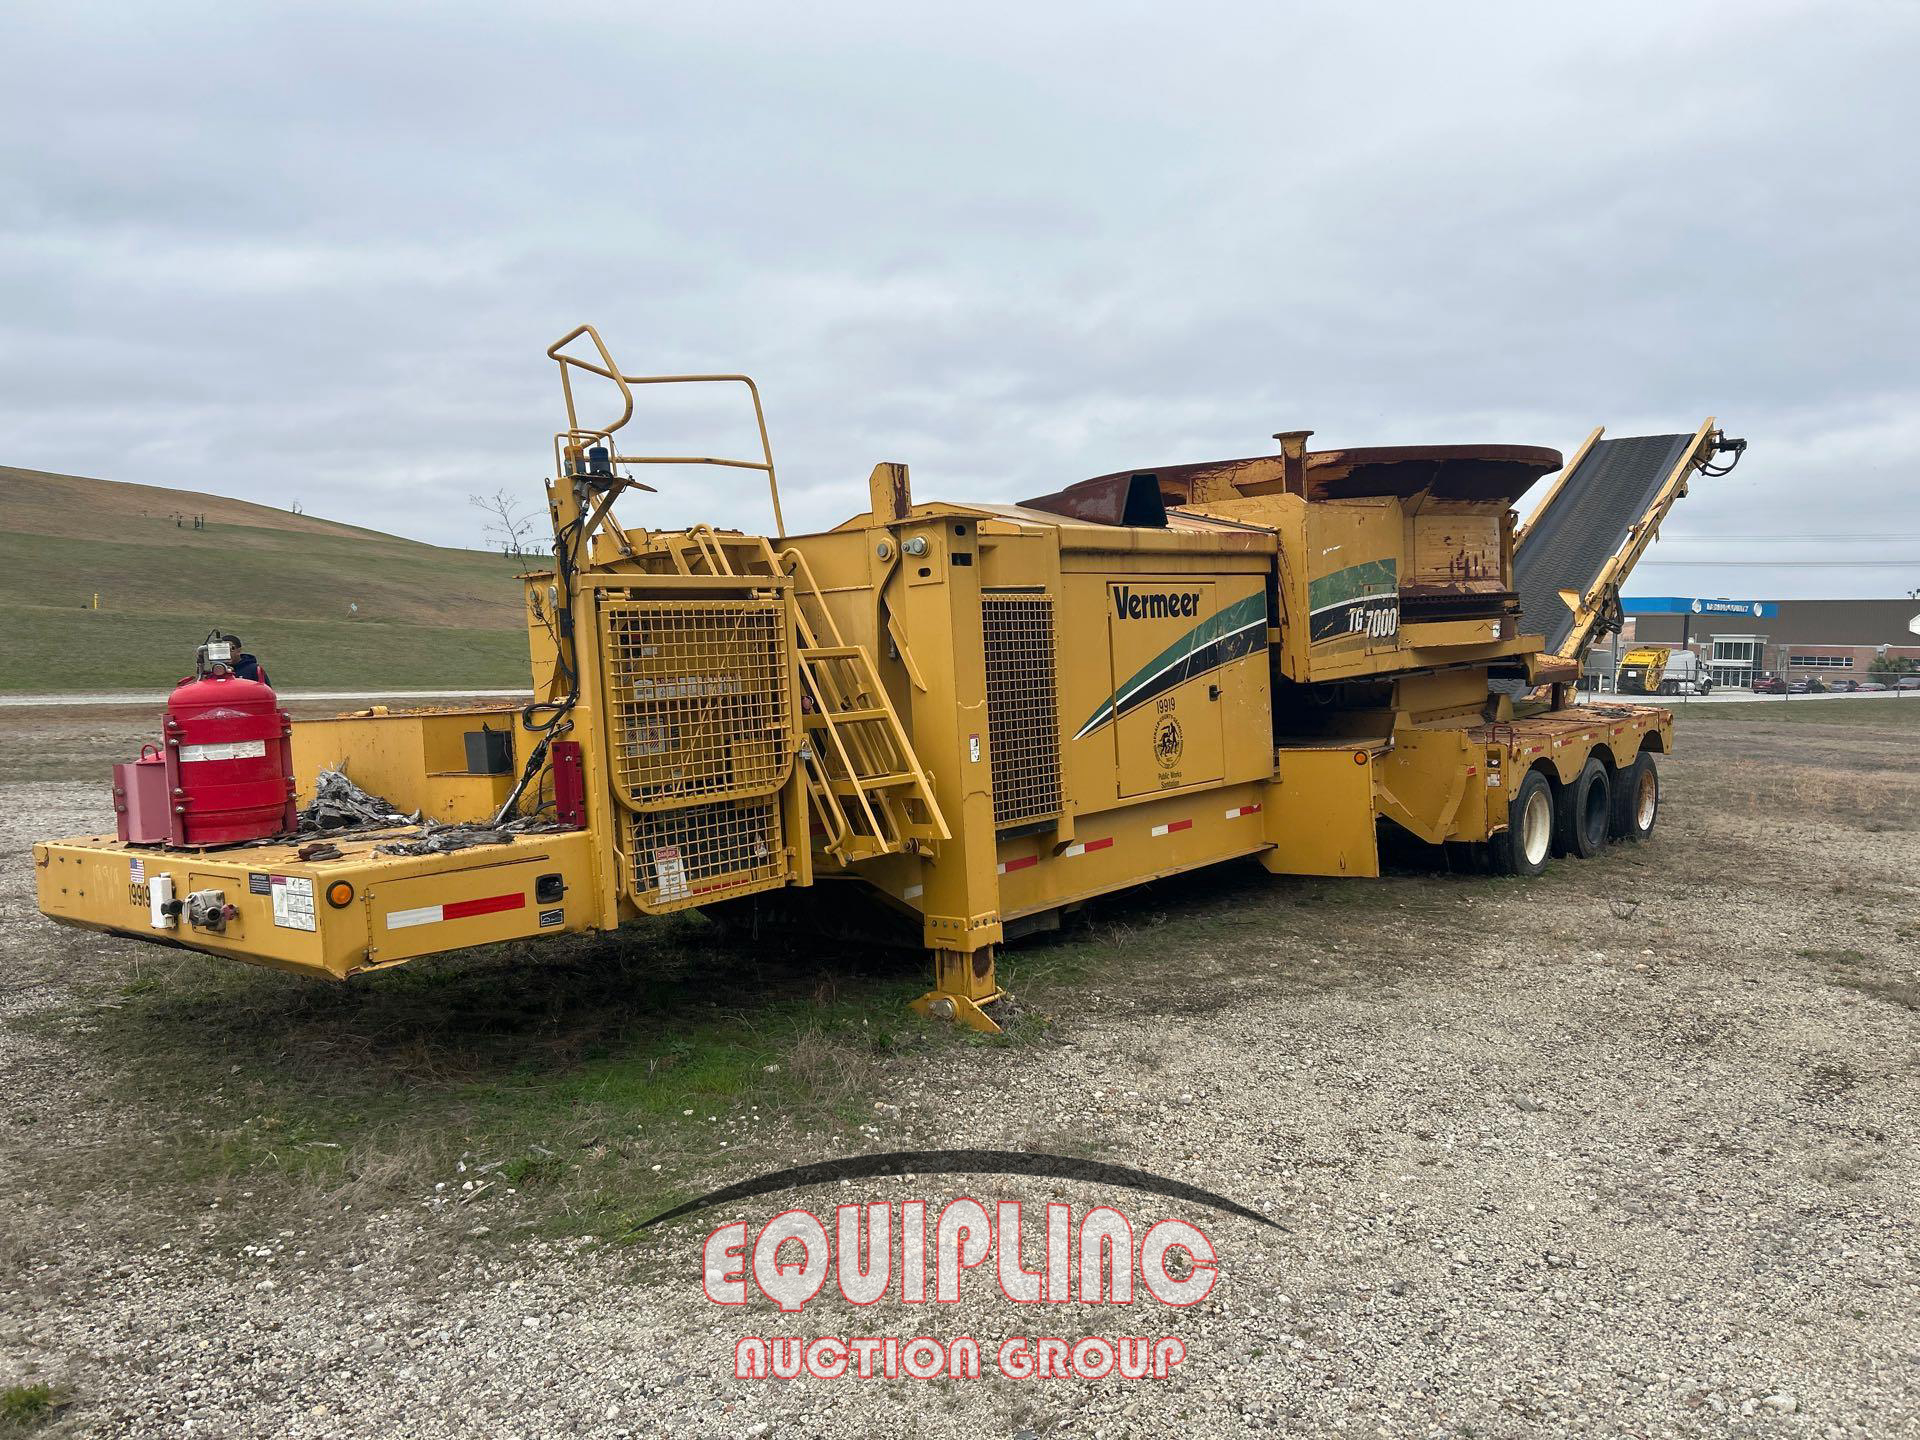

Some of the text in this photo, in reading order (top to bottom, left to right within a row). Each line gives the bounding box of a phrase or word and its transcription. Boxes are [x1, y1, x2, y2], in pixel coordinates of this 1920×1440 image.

[1113, 586, 1199, 619] Vermeer
[1349, 607, 1397, 639] TG 7000
[1156, 697, 1176, 714] 19919
[128, 883, 151, 908] 19919
